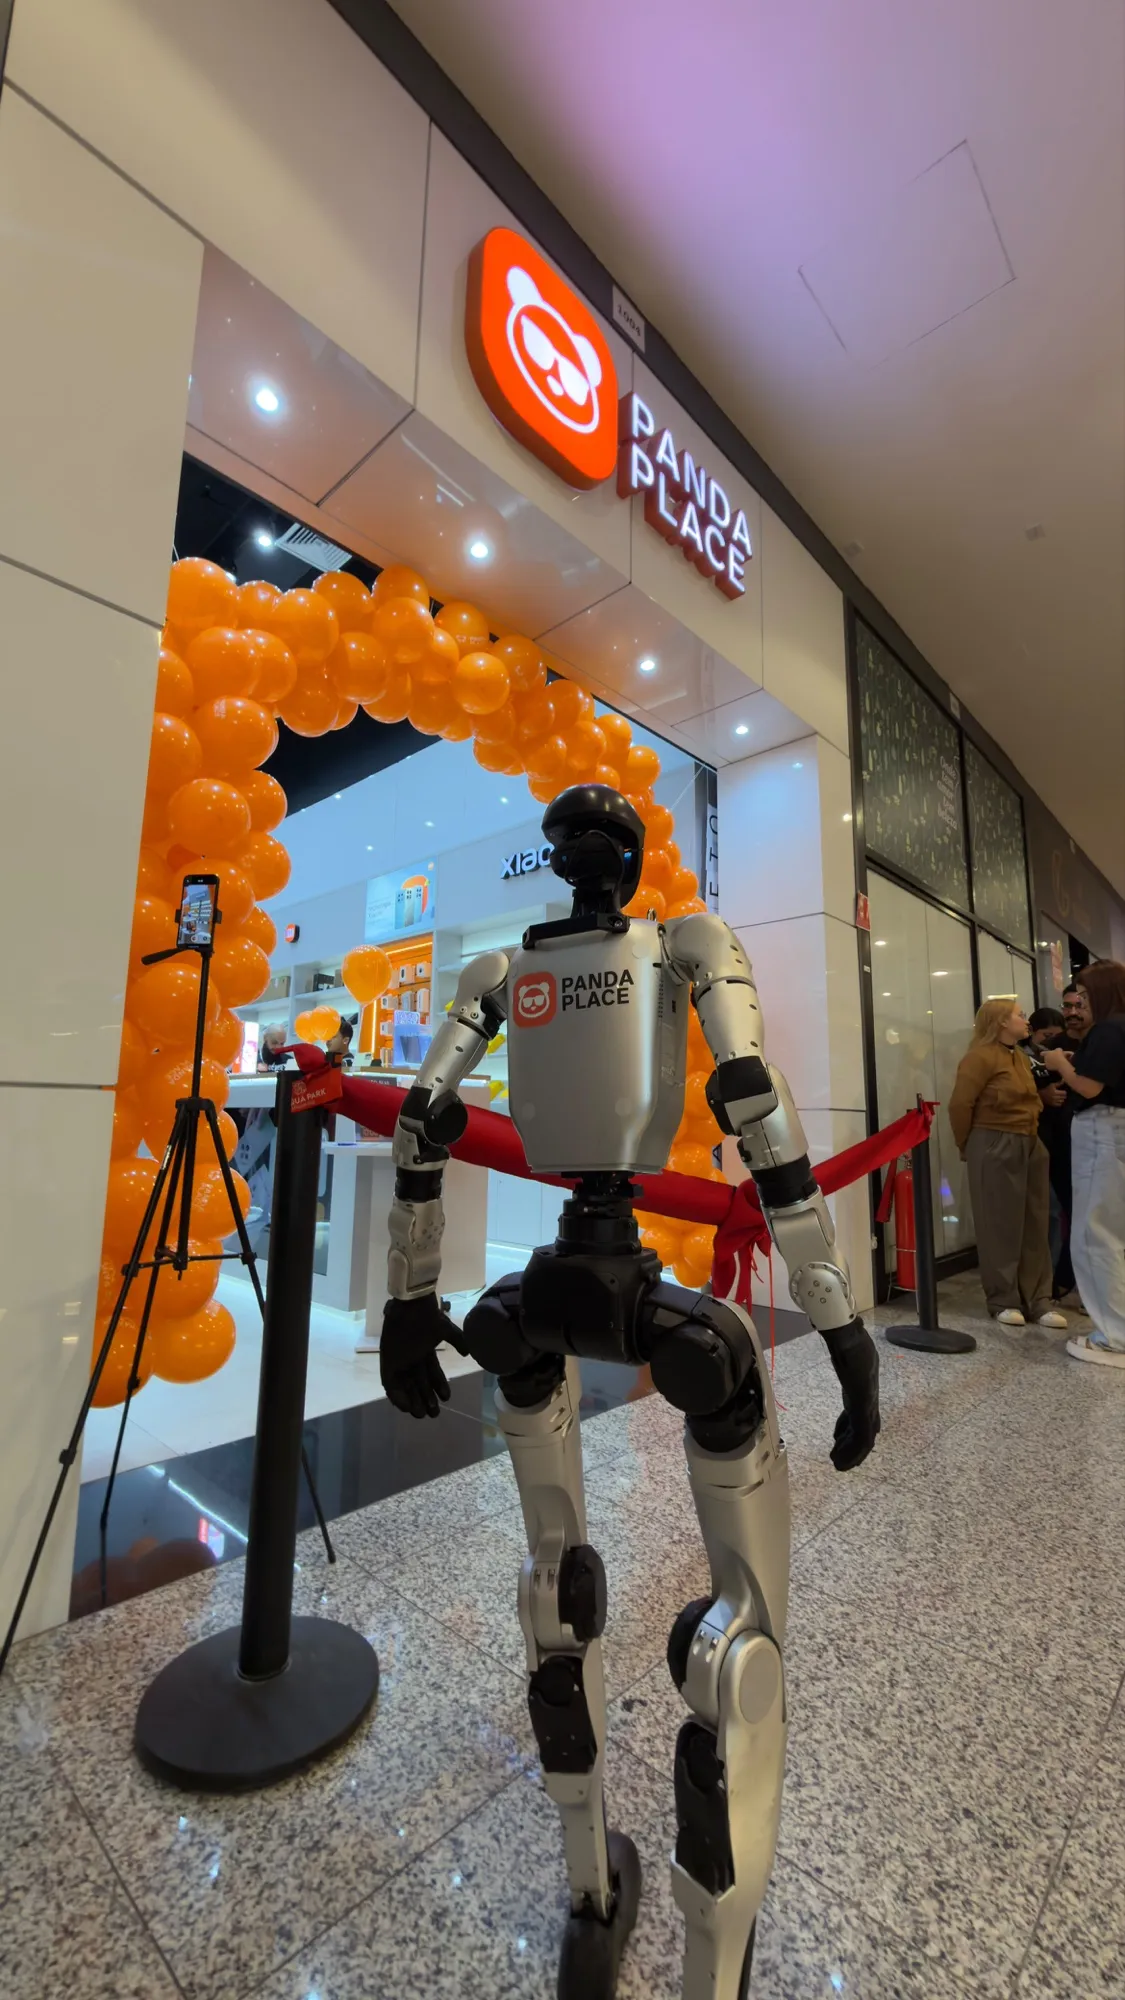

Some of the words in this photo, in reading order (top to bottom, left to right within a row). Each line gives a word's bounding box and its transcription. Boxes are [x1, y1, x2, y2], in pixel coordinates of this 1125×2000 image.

[631, 392, 752, 556] PANDA
[631, 443, 745, 592] PLACE
[562, 969, 634, 994] PANDA
[562, 987, 630, 1011] PLACE
[306, 1087, 326, 1101] PARK
